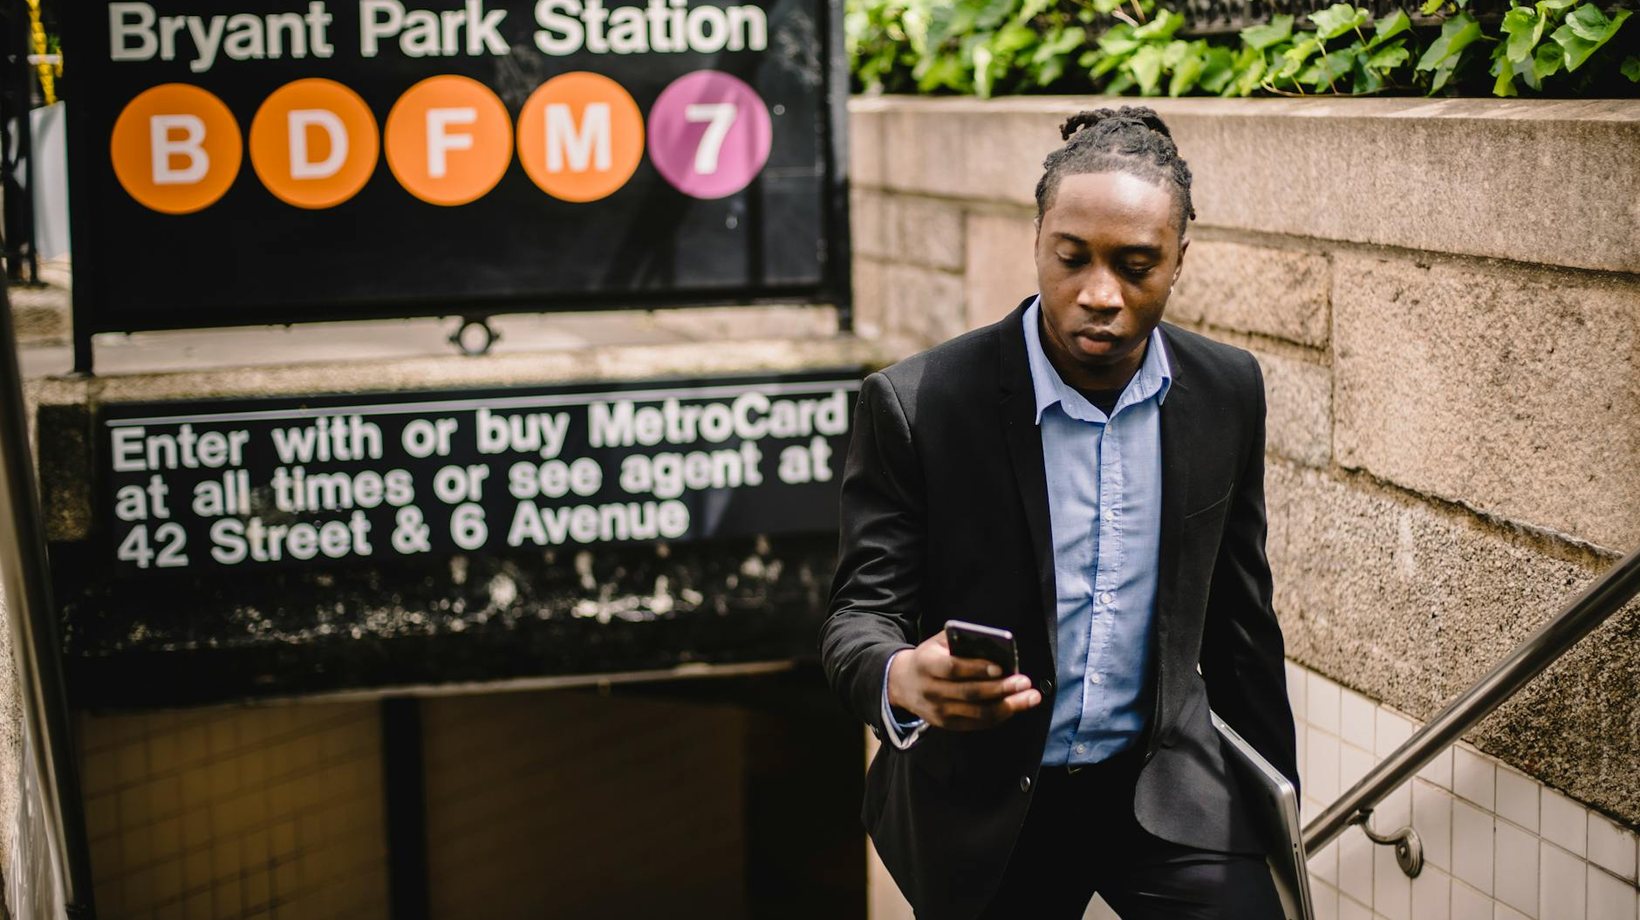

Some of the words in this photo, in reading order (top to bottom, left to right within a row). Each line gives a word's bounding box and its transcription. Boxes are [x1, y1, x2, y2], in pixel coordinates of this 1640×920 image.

[110, 1, 333, 71] Bryant
[360, 0, 510, 57] Park
[535, 0, 767, 55] Station
[152, 116, 208, 183] B
[289, 110, 347, 178] D
[426, 107, 477, 178] F
[544, 102, 613, 173] M
[686, 104, 738, 175] 7
[112, 425, 248, 470] Enter
[273, 416, 382, 463] with
[402, 419, 457, 457] or
[476, 408, 570, 457] buy
[588, 393, 848, 448] MetroCard
[117, 475, 169, 520] at
[193, 470, 250, 516] all
[271, 466, 414, 511] times
[434, 464, 489, 503] or
[509, 458, 602, 498] see
[620, 440, 762, 498] agent
[779, 436, 831, 483] at
[119, 524, 187, 567] 42
[211, 511, 372, 563] Street
[392, 506, 430, 553] &
[451, 503, 487, 549] 6
[508, 500, 689, 546] Avenue
